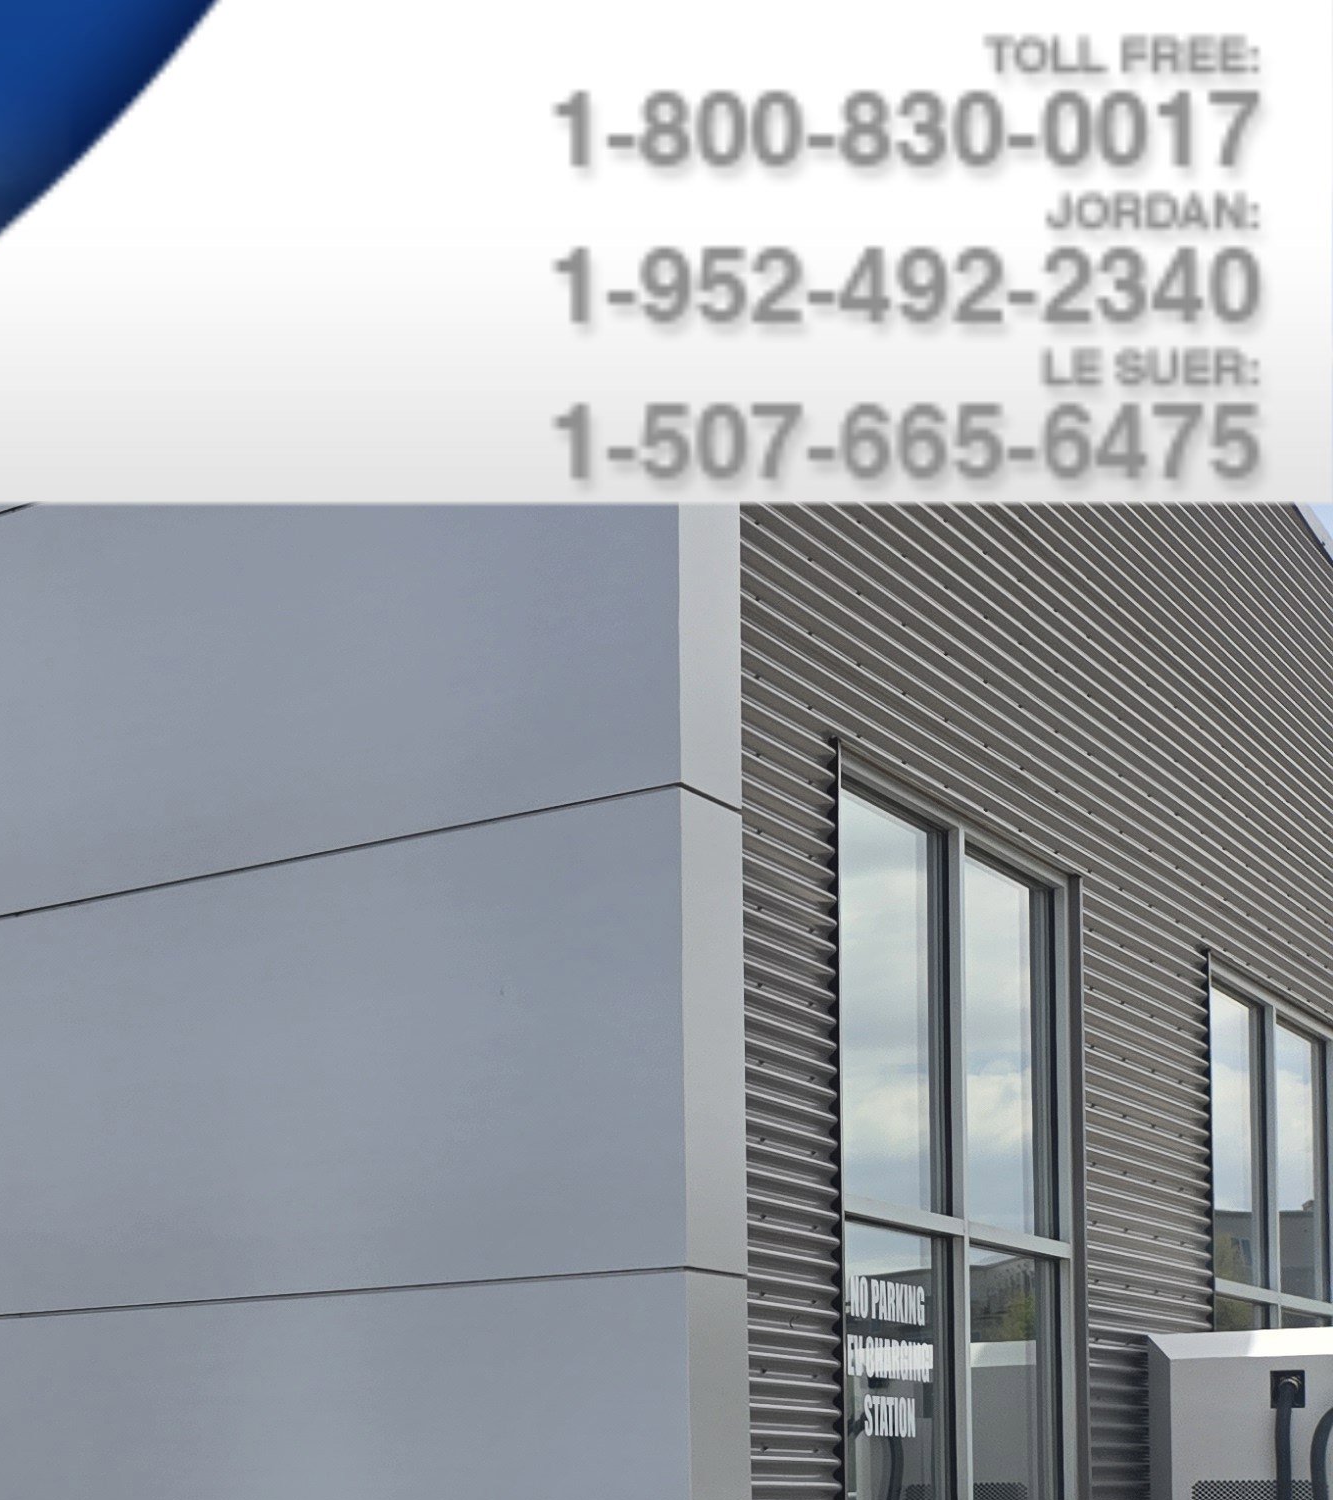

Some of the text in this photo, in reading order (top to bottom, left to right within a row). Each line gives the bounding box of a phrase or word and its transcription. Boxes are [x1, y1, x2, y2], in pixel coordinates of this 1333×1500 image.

[850, 1275, 926, 1327] NO PARKING
[864, 1394, 916, 1438] STATION
